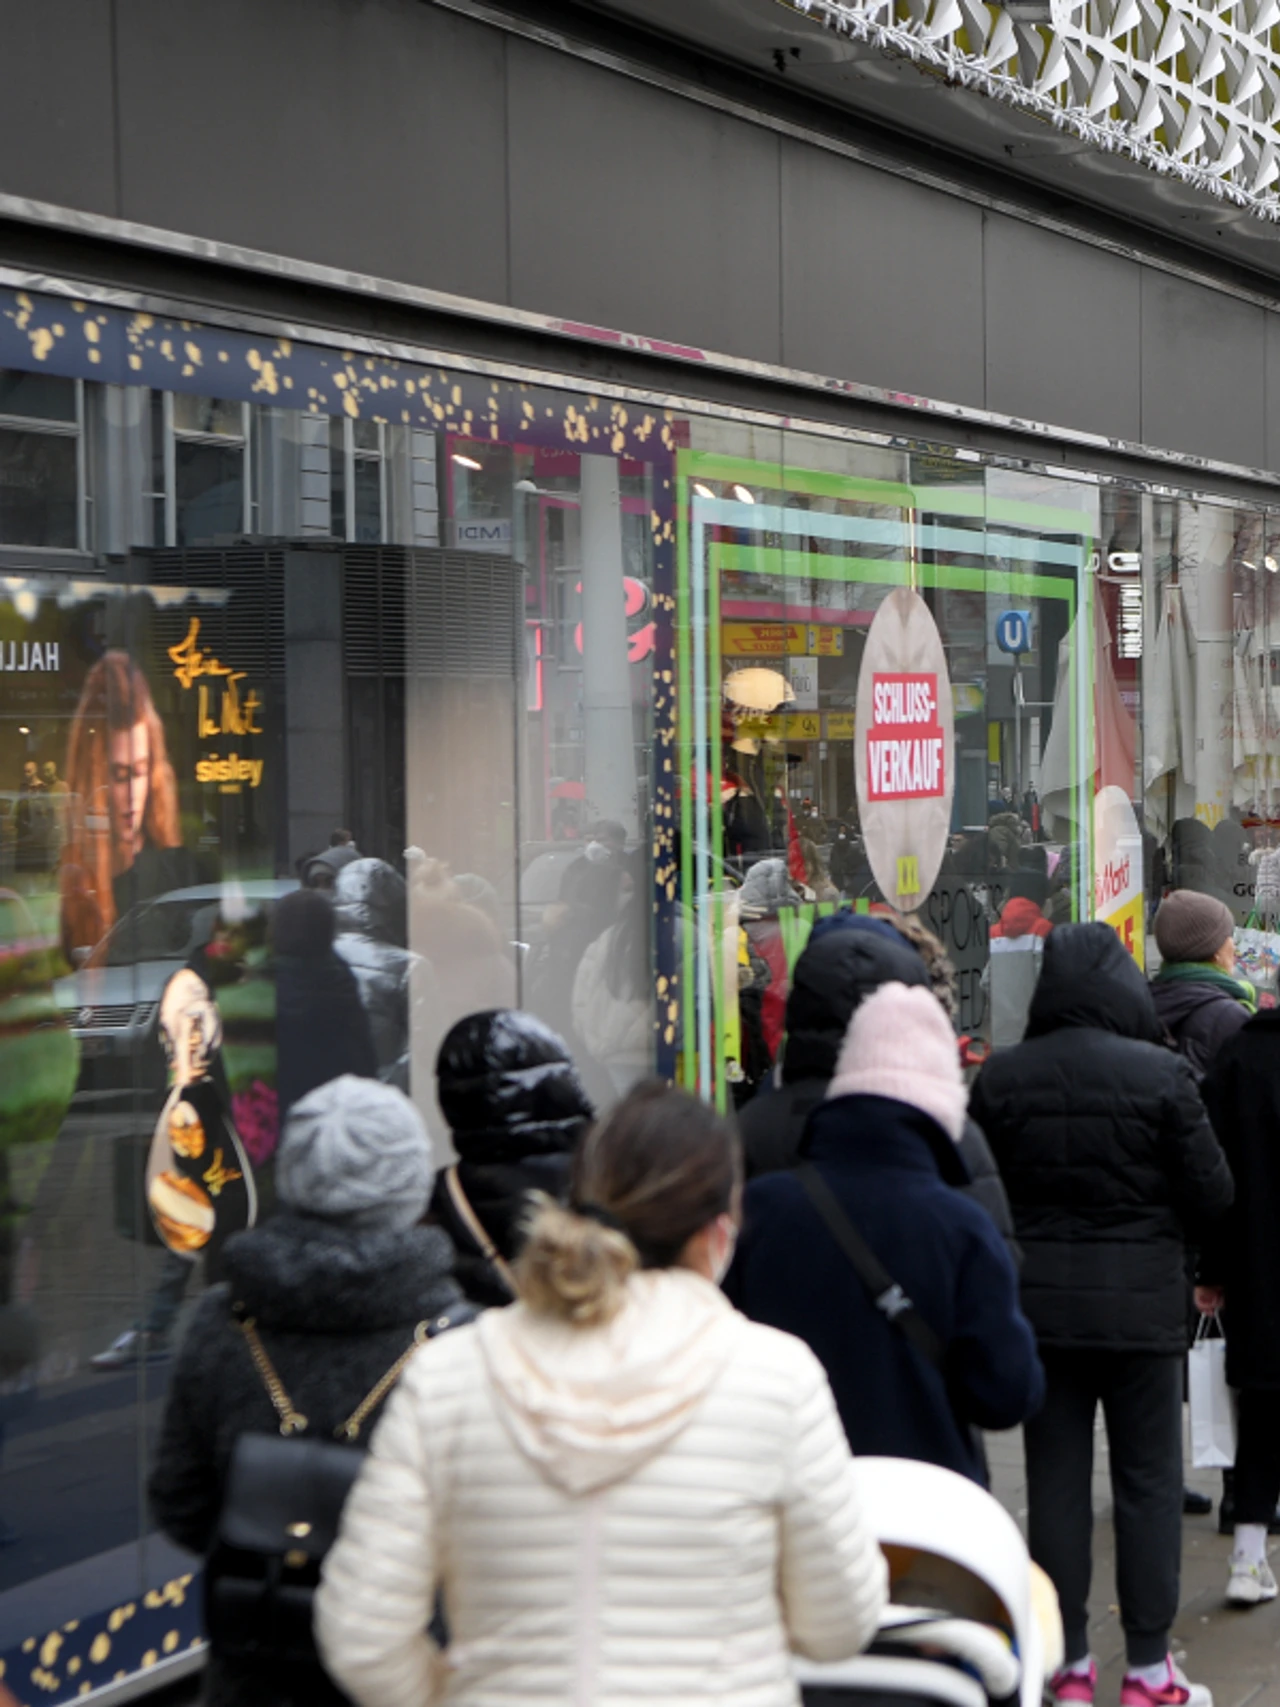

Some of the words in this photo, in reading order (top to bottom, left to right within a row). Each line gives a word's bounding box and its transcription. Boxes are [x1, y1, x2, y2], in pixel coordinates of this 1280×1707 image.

[874, 682, 936, 724] SCHLUSS-
[195, 752, 264, 788] sisley
[868, 738, 943, 794] VERKAUF
